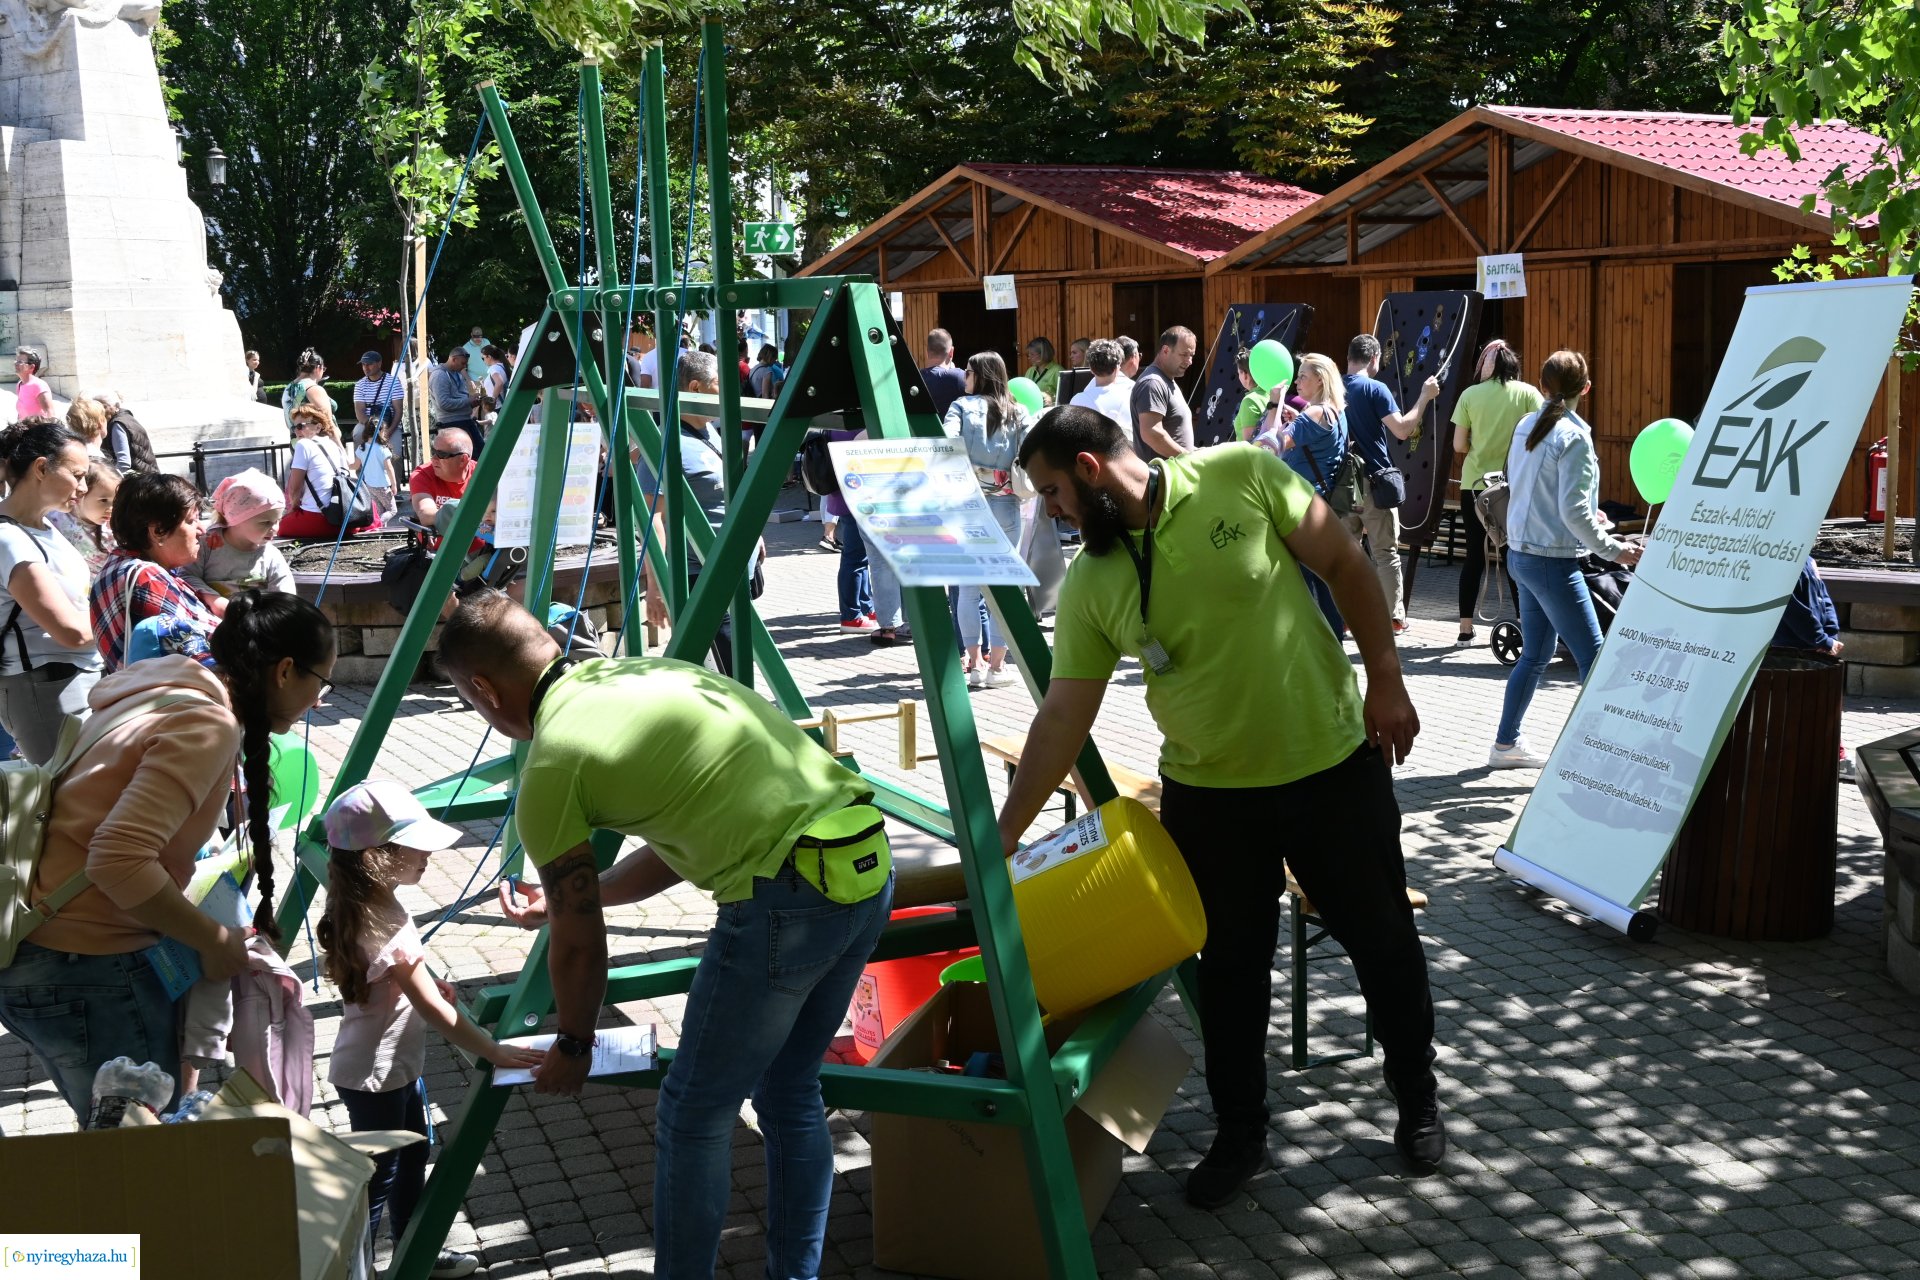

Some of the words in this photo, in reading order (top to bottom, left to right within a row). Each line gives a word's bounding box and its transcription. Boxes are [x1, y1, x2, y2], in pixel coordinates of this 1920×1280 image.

[1486, 263, 1521, 275] SAJTFAL
[1690, 500, 1776, 530] Észak-Alföldi
[1666, 551, 1731, 578] Nonprofit
[1728, 559, 1751, 582] Kft.
[1618, 627, 1639, 641] 4400
[1637, 631, 1682, 653] Nyíregyháza,
[1683, 641, 1711, 657] Bokréta
[1711, 650, 1720, 660] u.
[1721, 650, 1736, 664] 22.
[1630, 670, 1646, 682] +36
[1645, 673, 1690, 693] 42/508-369
[1603, 702, 1683, 733] www.eakhulladek.hu
[1582, 734, 1671, 773] facebook.com/eakhulladek
